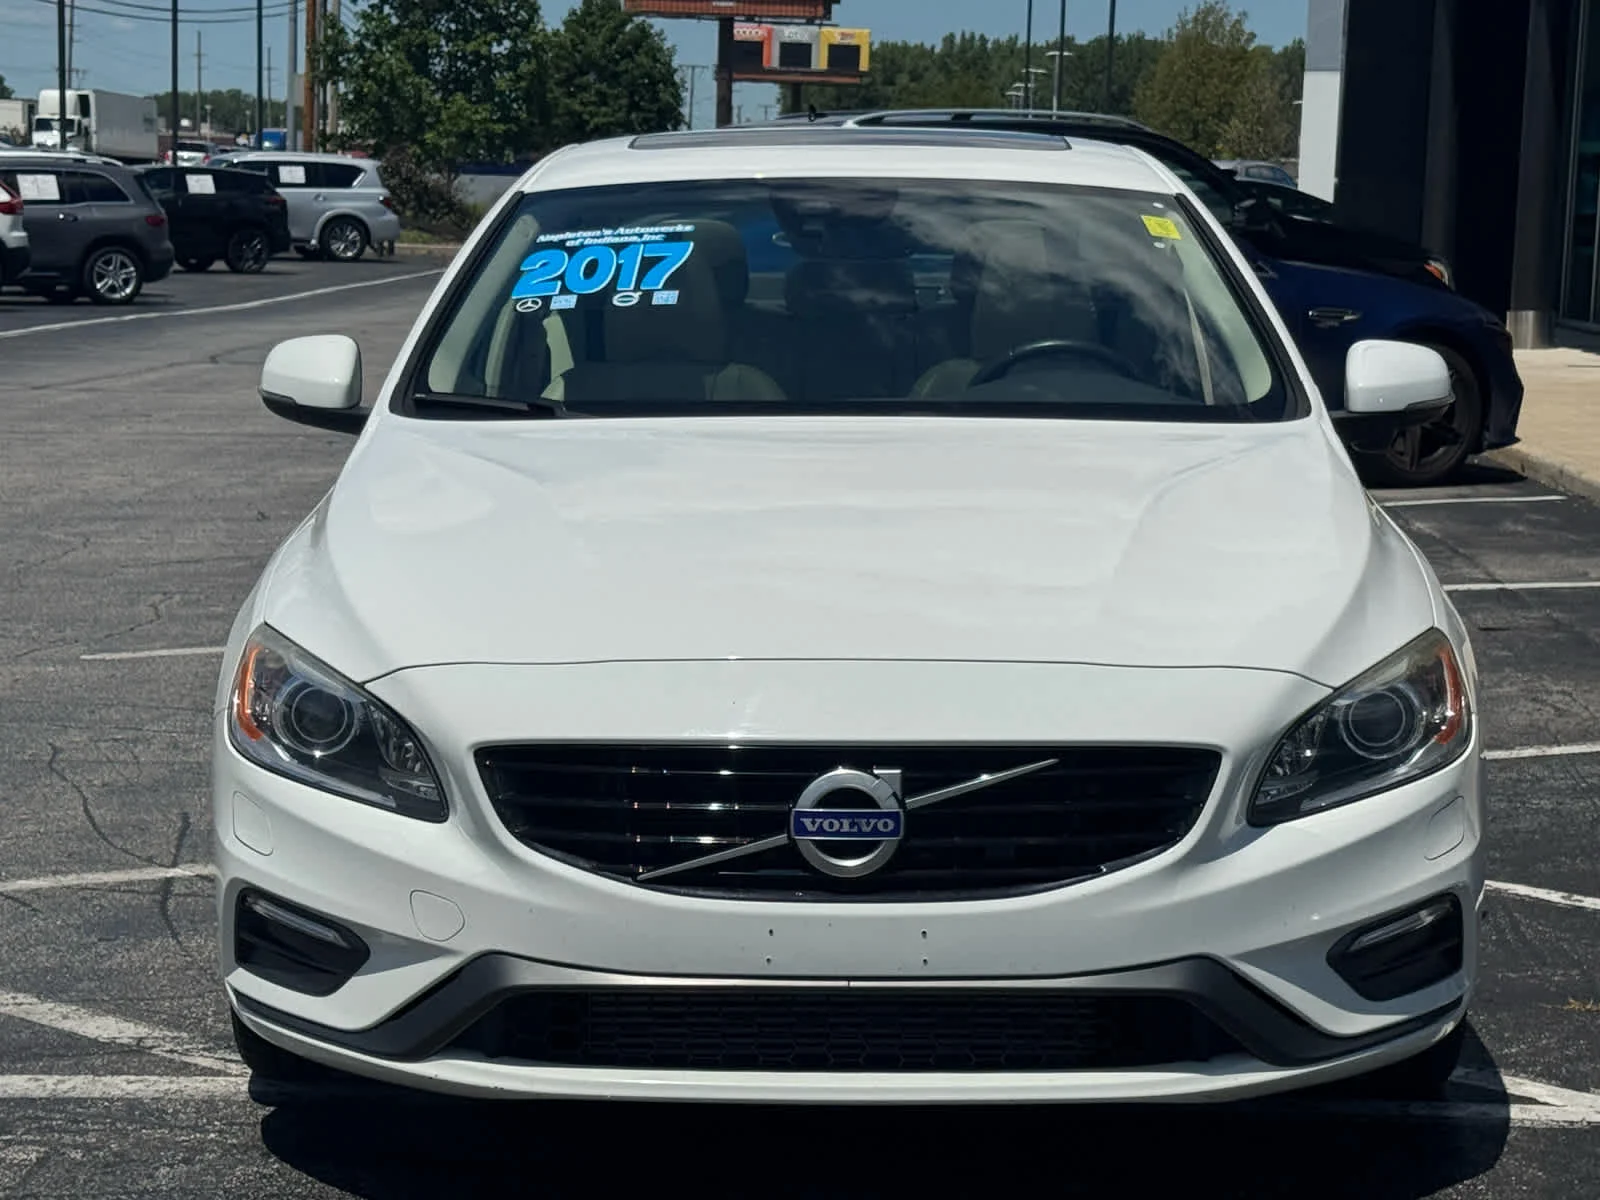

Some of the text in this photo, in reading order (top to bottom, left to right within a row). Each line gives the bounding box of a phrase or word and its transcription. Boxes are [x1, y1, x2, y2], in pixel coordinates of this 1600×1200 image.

[565, 238, 584, 247] of
[511, 241, 694, 299] 2017
[800, 817, 895, 833] VOLVO
